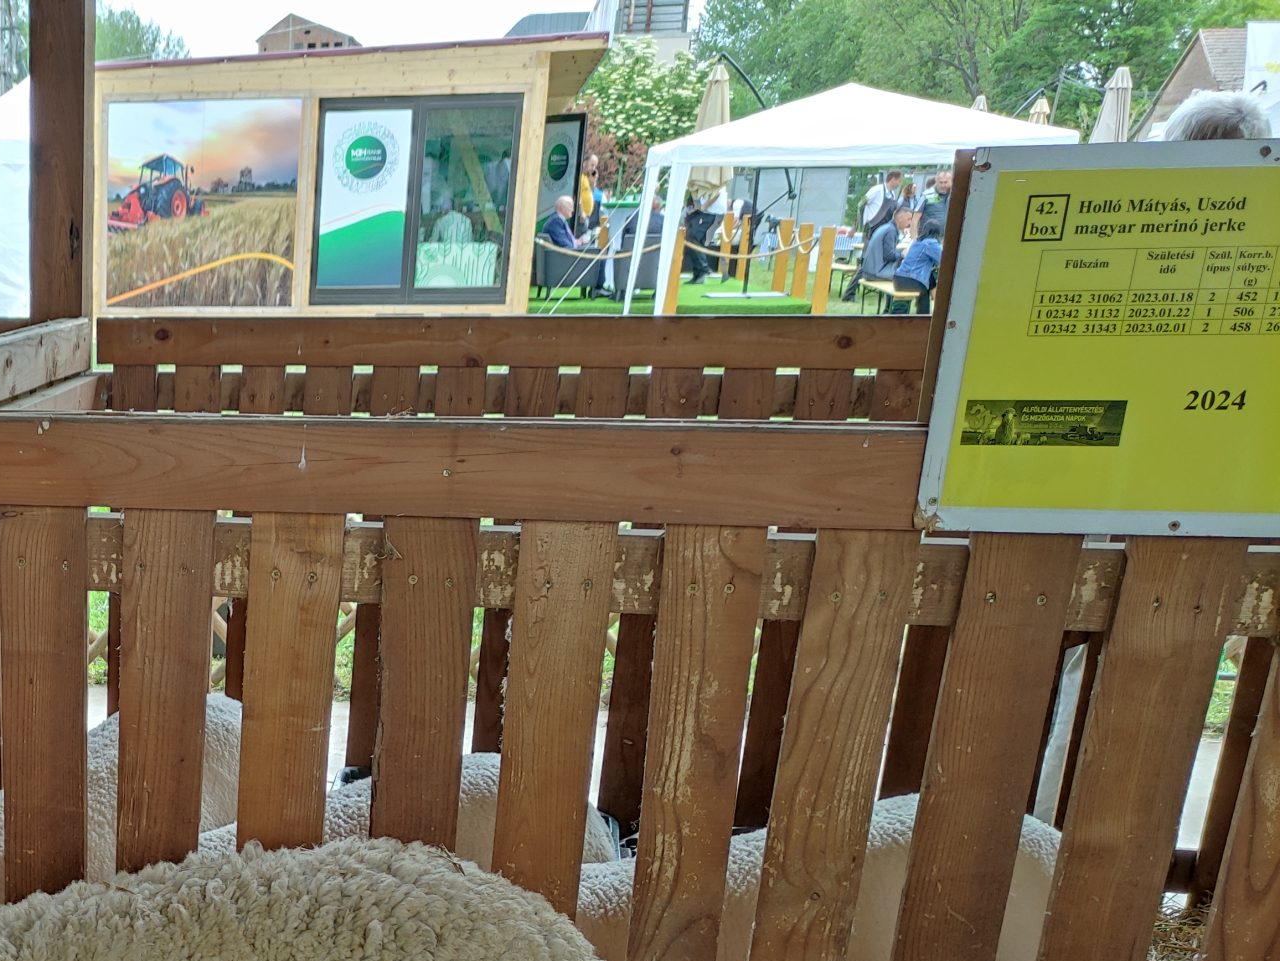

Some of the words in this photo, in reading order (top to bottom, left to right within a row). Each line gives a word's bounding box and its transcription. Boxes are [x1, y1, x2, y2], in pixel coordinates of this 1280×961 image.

[1036, 201, 1058, 215] 42.
[1078, 200, 1122, 214] Holló
[1127, 198, 1191, 215] Mátyás,
[1197, 196, 1247, 211] Uszód
[1029, 222, 1058, 236] box
[1074, 223, 1136, 238] magyar
[1140, 219, 1198, 233] merinó
[1200, 218, 1246, 235] jerke
[1147, 250, 1195, 260] Születési
[1065, 259, 1109, 269] Fülszám
[1243, 277, 1258, 287] (g)
[1048, 293, 1083, 304] 02342
[1087, 293, 1123, 304] 31062
[1131, 292, 1194, 303] 2023.01.18
[1208, 292, 1216, 302] 2
[1236, 291, 1258, 302] 452
[1045, 308, 1080, 319] 02342
[1085, 308, 1120, 319] 31132
[1128, 308, 1190, 318] 2023.01.22
[1206, 308, 1212, 318] 1
[1233, 306, 1255, 317] 506
[1043, 323, 1077, 334] 02342
[1082, 323, 1117, 334] 31343
[1125, 323, 1186, 333] 2023.02.01
[1201, 322, 1210, 333] 2
[1230, 321, 1252, 332] 458
[1183, 389, 1247, 411] 2024
